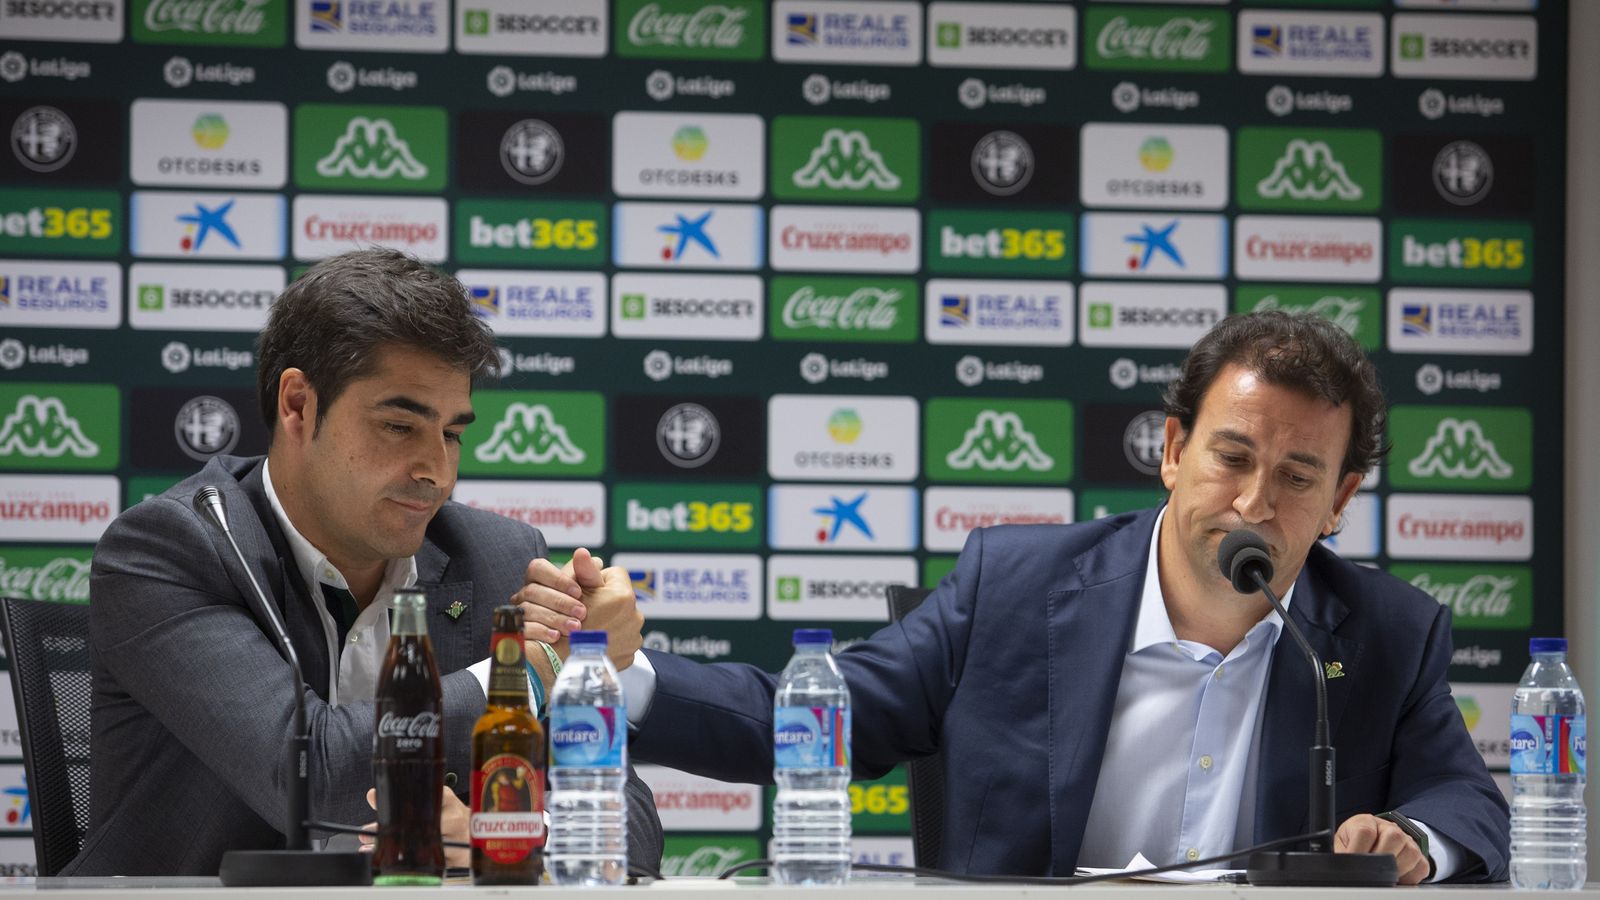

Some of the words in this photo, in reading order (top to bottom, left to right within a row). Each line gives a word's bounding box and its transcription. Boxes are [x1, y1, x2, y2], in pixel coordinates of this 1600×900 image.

[349, 1, 434, 18] REALE
[824, 14, 909, 31] REALE
[1288, 26, 1372, 43] REALE
[30, 58, 91, 79] LaLiga
[195, 63, 256, 85] LaLiga
[358, 68, 418, 90] LaLiga
[517, 71, 577, 94] LaLiga
[675, 75, 735, 97] LaLiga
[833, 79, 891, 102] LaLiga
[988, 84, 1047, 107] LaLiga
[1142, 88, 1199, 110] LaLiga
[1295, 91, 1352, 114] LaLiga
[1448, 95, 1504, 117] LaLiga
[157, 157, 262, 176] OTCDESKS
[639, 169, 739, 187] OTCDESKS
[1106, 178, 1204, 196] OTCDESKS
[0, 208, 112, 239] et365
[304, 216, 439, 245] Cruzcampo
[470, 216, 598, 250] bet365
[781, 225, 911, 254] Cruzcampo
[940, 226, 1066, 259] bet365
[1245, 235, 1373, 264] Cruzcampo
[1402, 235, 1525, 269] bet365
[18, 276, 107, 294] REALE
[506, 286, 594, 304] REALE
[977, 295, 1060, 312] REALE
[1438, 304, 1521, 321] REALE
[28, 345, 89, 367] LaLiga
[192, 347, 254, 370] LaLiga
[515, 353, 575, 375] LaLiga
[674, 356, 733, 378] LaLiga
[829, 358, 888, 381] LaLiga
[985, 361, 1043, 384] LaLiga
[1445, 369, 1502, 391] LaLiga
[795, 451, 893, 468] OTCDESKS
[0, 500, 109, 524] uzcampo
[626, 500, 753, 532] bet365
[1397, 513, 1525, 545] Cruzcampo
[663, 570, 749, 587] REALE
[807, 580, 887, 599] BESOCC
[671, 633, 731, 656] LaLiga
[1451, 647, 1502, 668] aLiga
[774, 727, 816, 745] ntarel
[1509, 735, 1540, 751] tarel
[849, 784, 909, 815] 365
[473, 815, 541, 834] Cruzcampo
